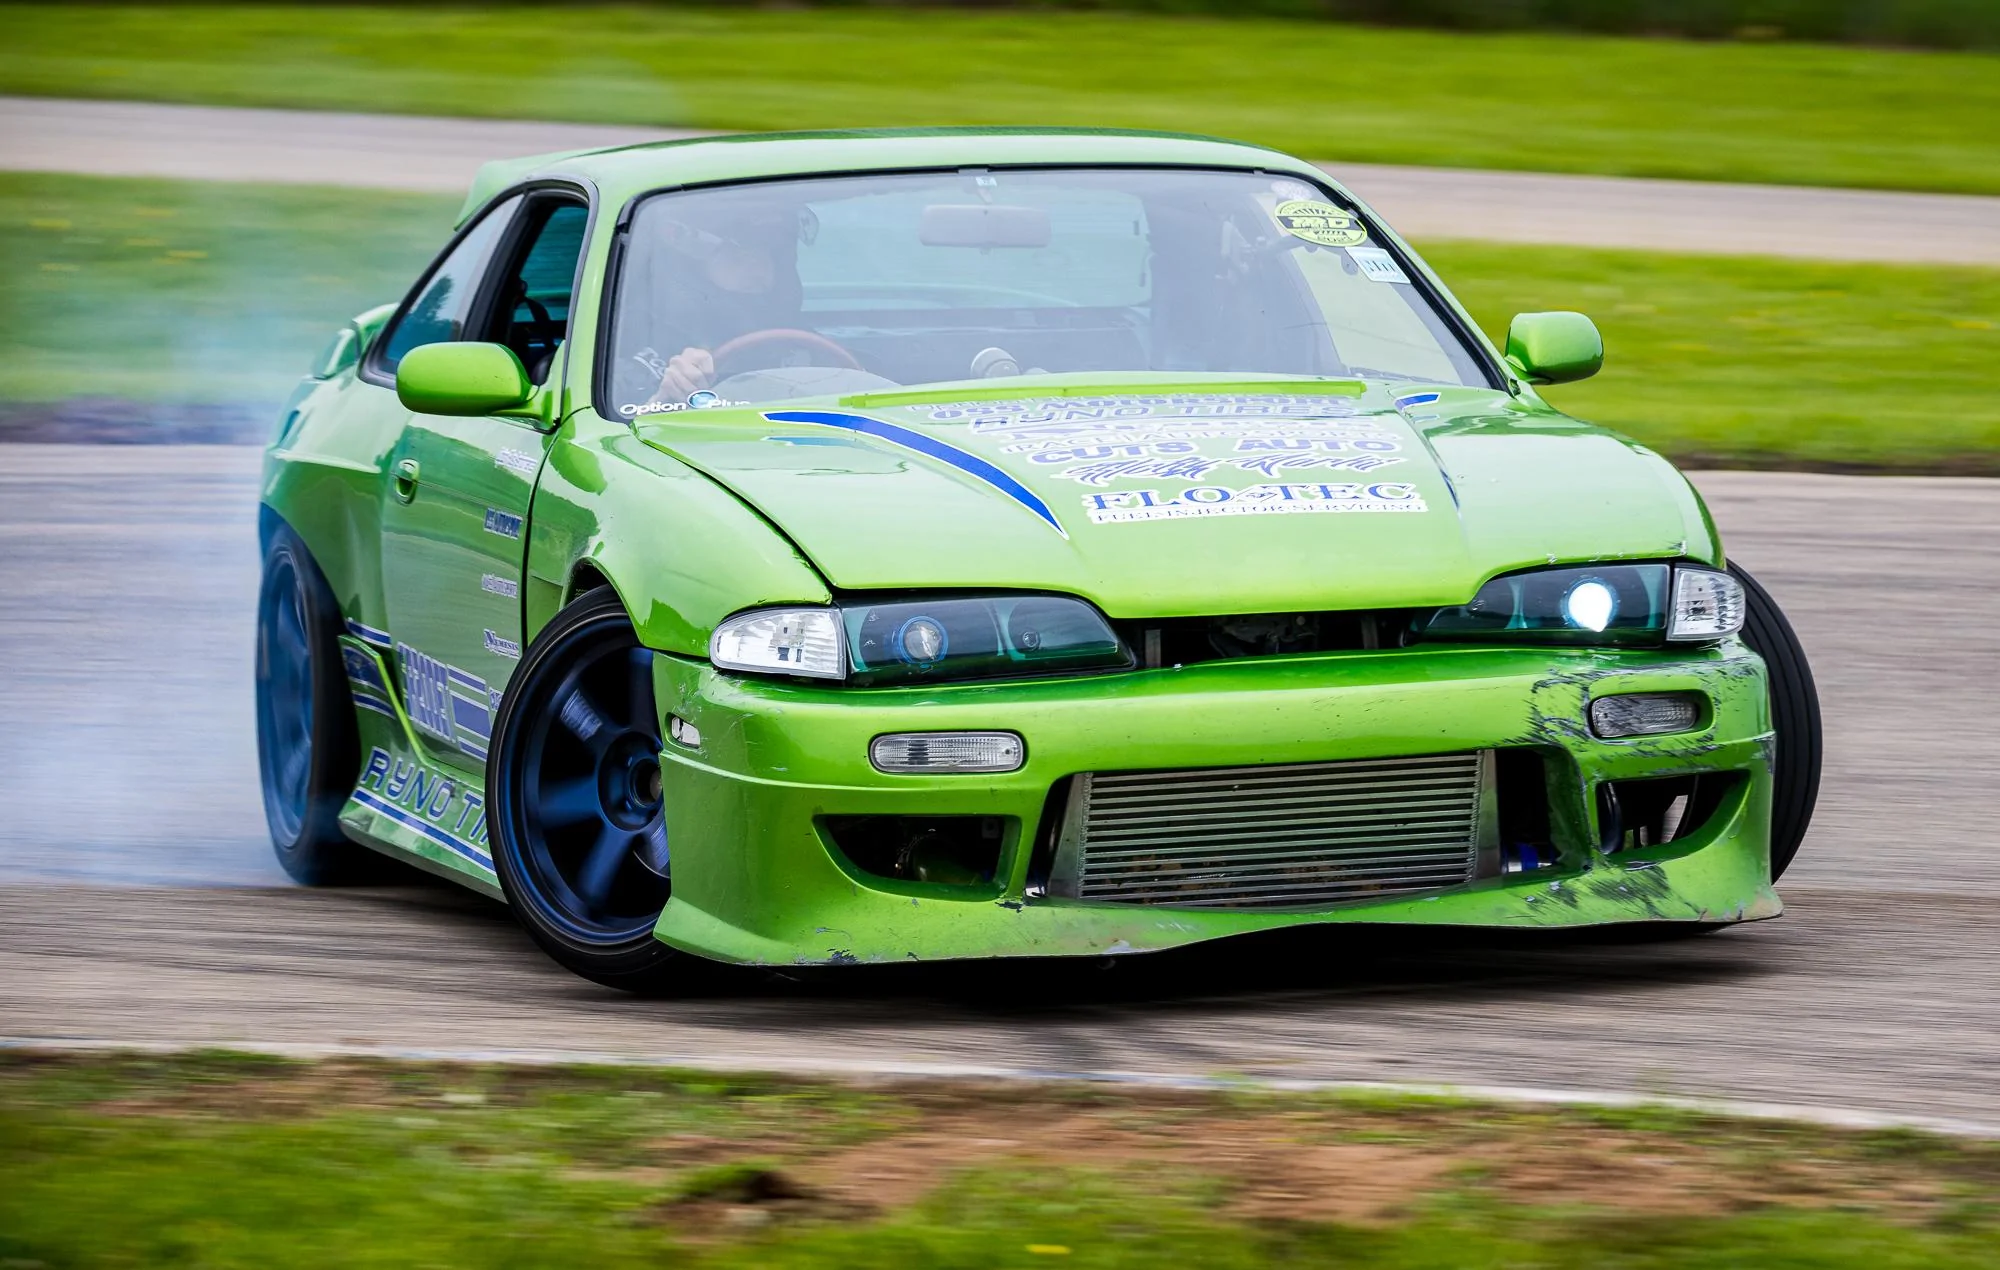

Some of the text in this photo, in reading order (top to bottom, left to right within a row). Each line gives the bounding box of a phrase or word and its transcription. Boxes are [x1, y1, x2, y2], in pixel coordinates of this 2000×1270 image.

[619, 401, 686, 416] Option
[973, 407, 1149, 429] RYNO
[1182, 404, 1355, 415] TIRES
[1031, 439, 1397, 463] CUTS AUTO
[1167, 504, 1285, 517] INJECTOR
[1291, 502, 1422, 512] SERVICING
[361, 747, 488, 844] RYNO TI
